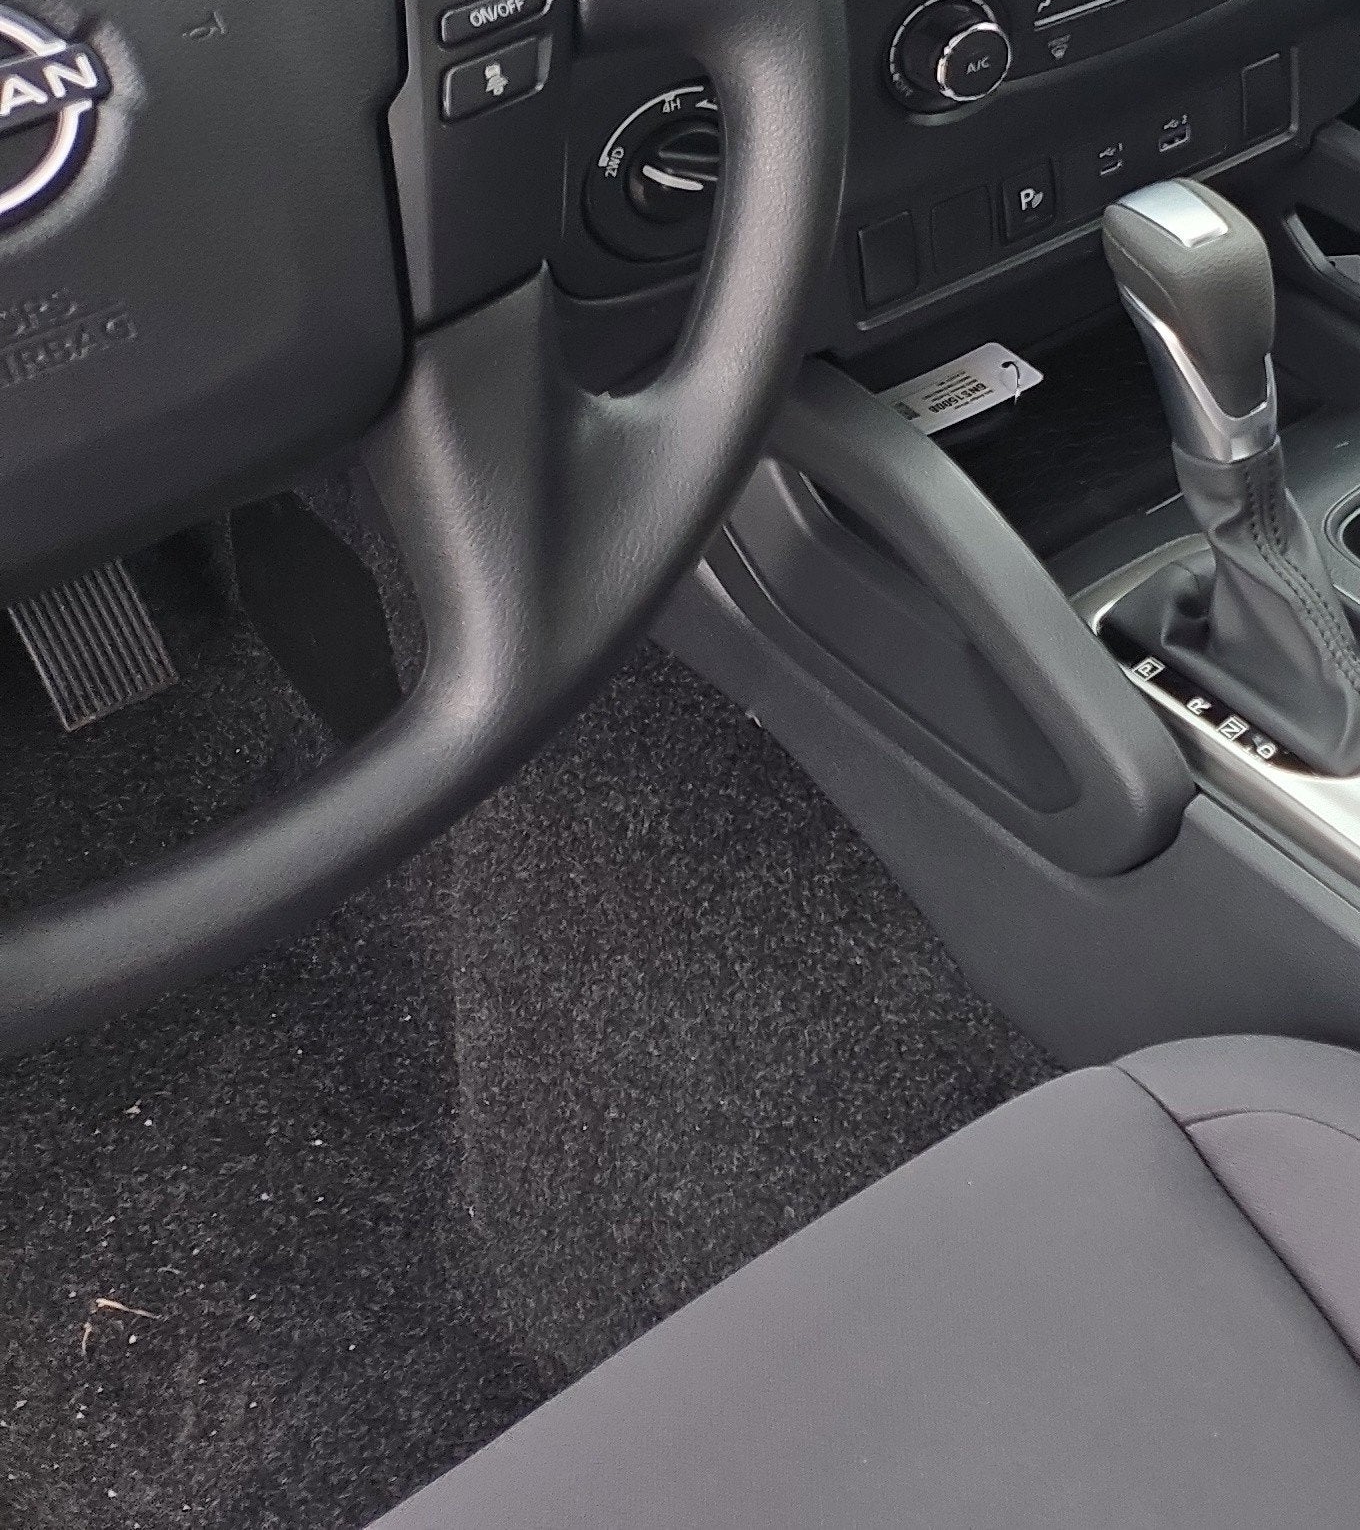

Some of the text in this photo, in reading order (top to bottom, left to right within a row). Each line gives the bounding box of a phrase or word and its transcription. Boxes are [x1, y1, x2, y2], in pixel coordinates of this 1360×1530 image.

[966, 56, 991, 74] A/C
[661, 97, 682, 114] 4H
[604, 126, 625, 178] 2WD
[1186, 696, 1212, 716] R
